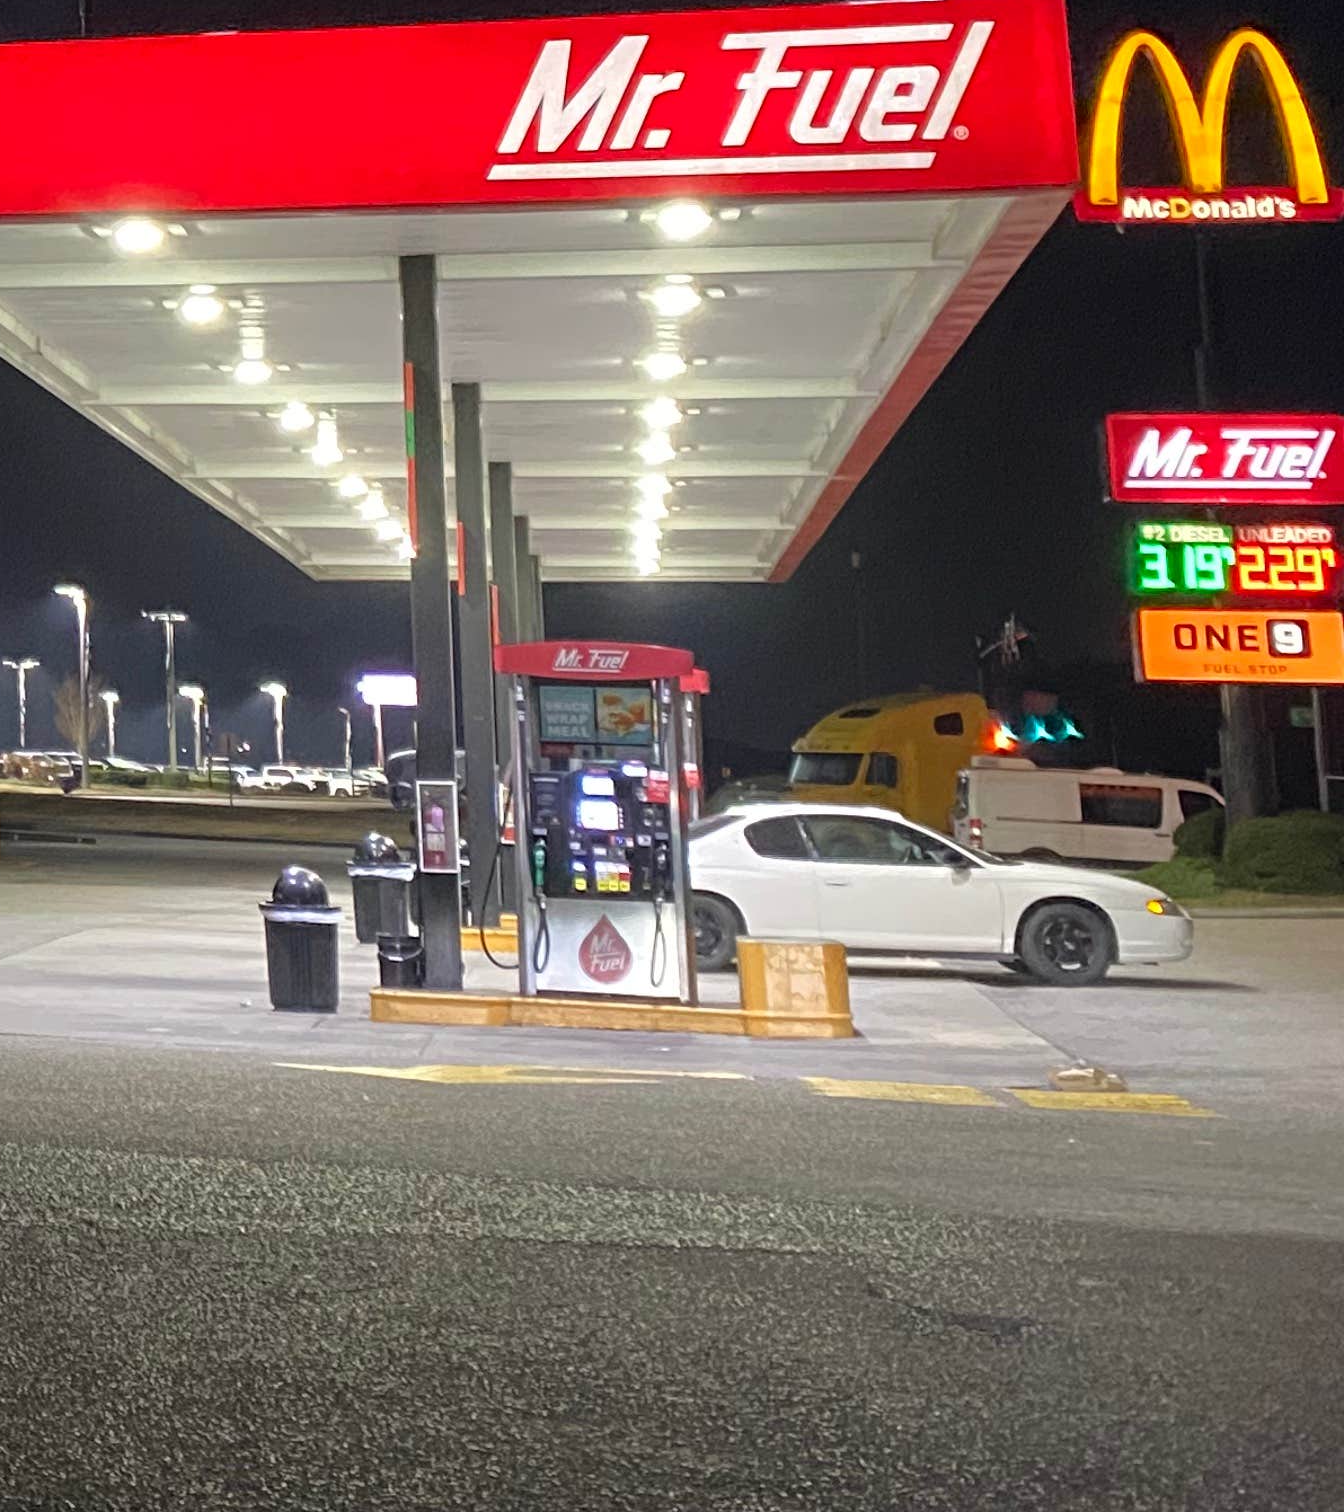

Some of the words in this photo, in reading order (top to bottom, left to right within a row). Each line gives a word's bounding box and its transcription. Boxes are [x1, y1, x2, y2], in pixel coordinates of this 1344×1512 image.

[498, 35, 685, 154] Mr.
[721, 21, 995, 147] Fuel
[1122, 195, 1297, 220] McDonald's
[1128, 427, 1209, 478] Mr.
[1219, 428, 1336, 479] Fuel
[1169, 526, 1230, 543] DIESEL
[1238, 526, 1333, 544] UNLEADED
[556, 648, 583, 668] Mr.
[588, 649, 630, 669] Fuel
[1202, 662, 1242, 675] FUEL
[1248, 663, 1288, 676] STOP
[546, 713, 589, 725] WRAP
[590, 952, 627, 973] Fuel
